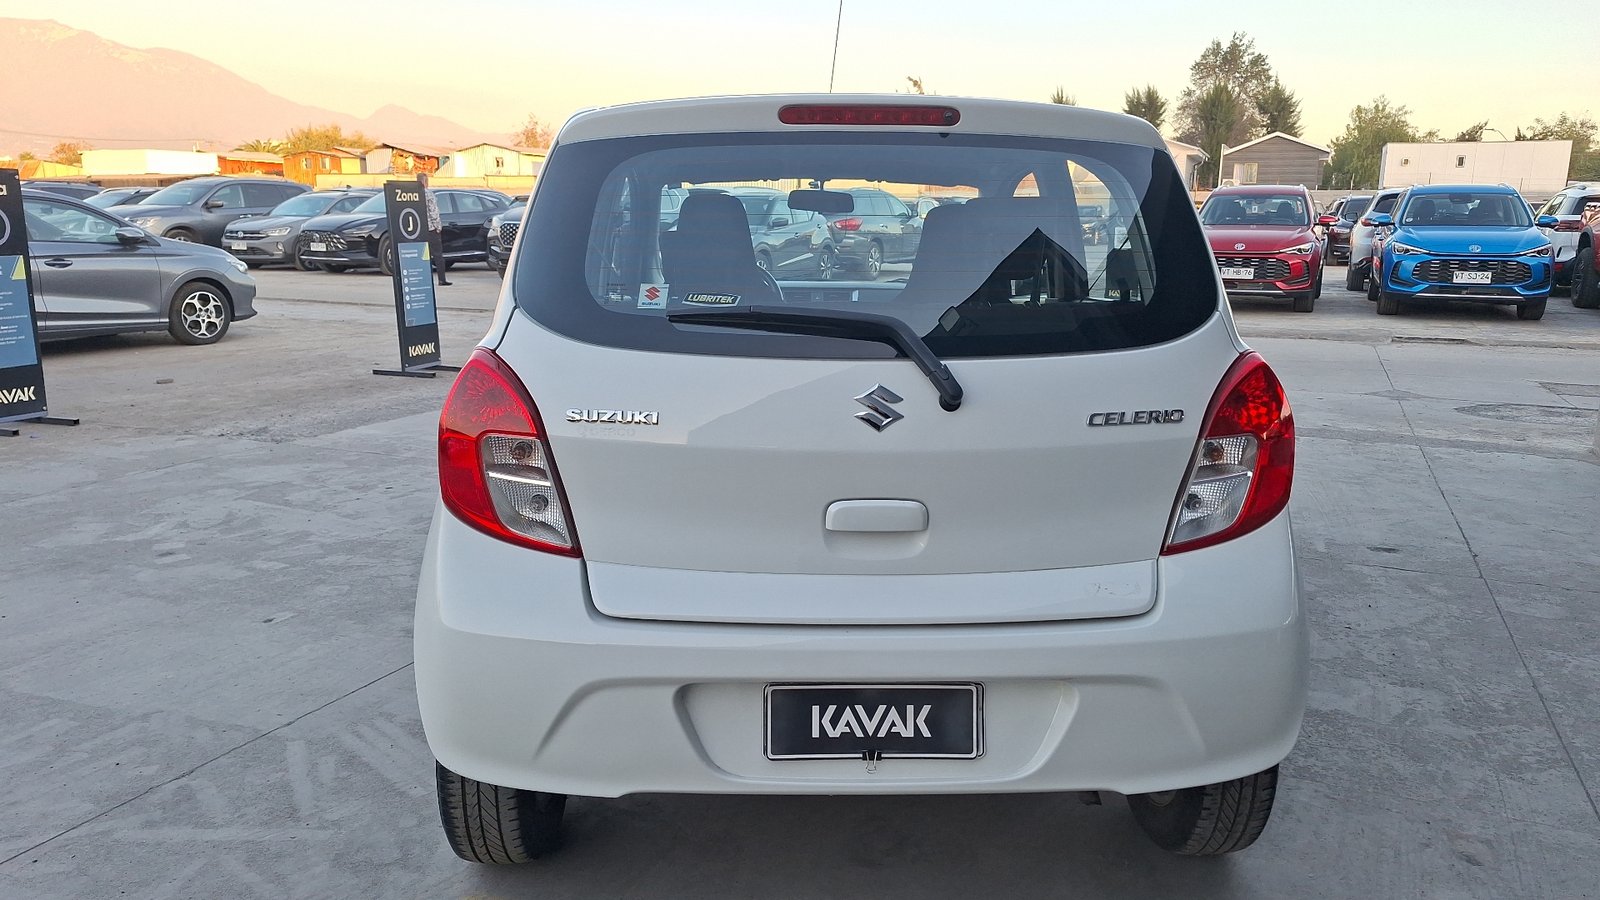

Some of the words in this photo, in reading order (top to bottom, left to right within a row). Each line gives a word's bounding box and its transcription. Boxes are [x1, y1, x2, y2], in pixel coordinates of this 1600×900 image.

[395, 189, 419, 202] Zona
[407, 216, 414, 232] J
[687, 293, 735, 304] LUBRITEK
[408, 342, 435, 358] KAVAK
[0, 385, 36, 404] AVAK
[566, 408, 659, 425] SUZUKI
[1086, 409, 1185, 427] CELERIO
[812, 705, 932, 738] KAVAK
